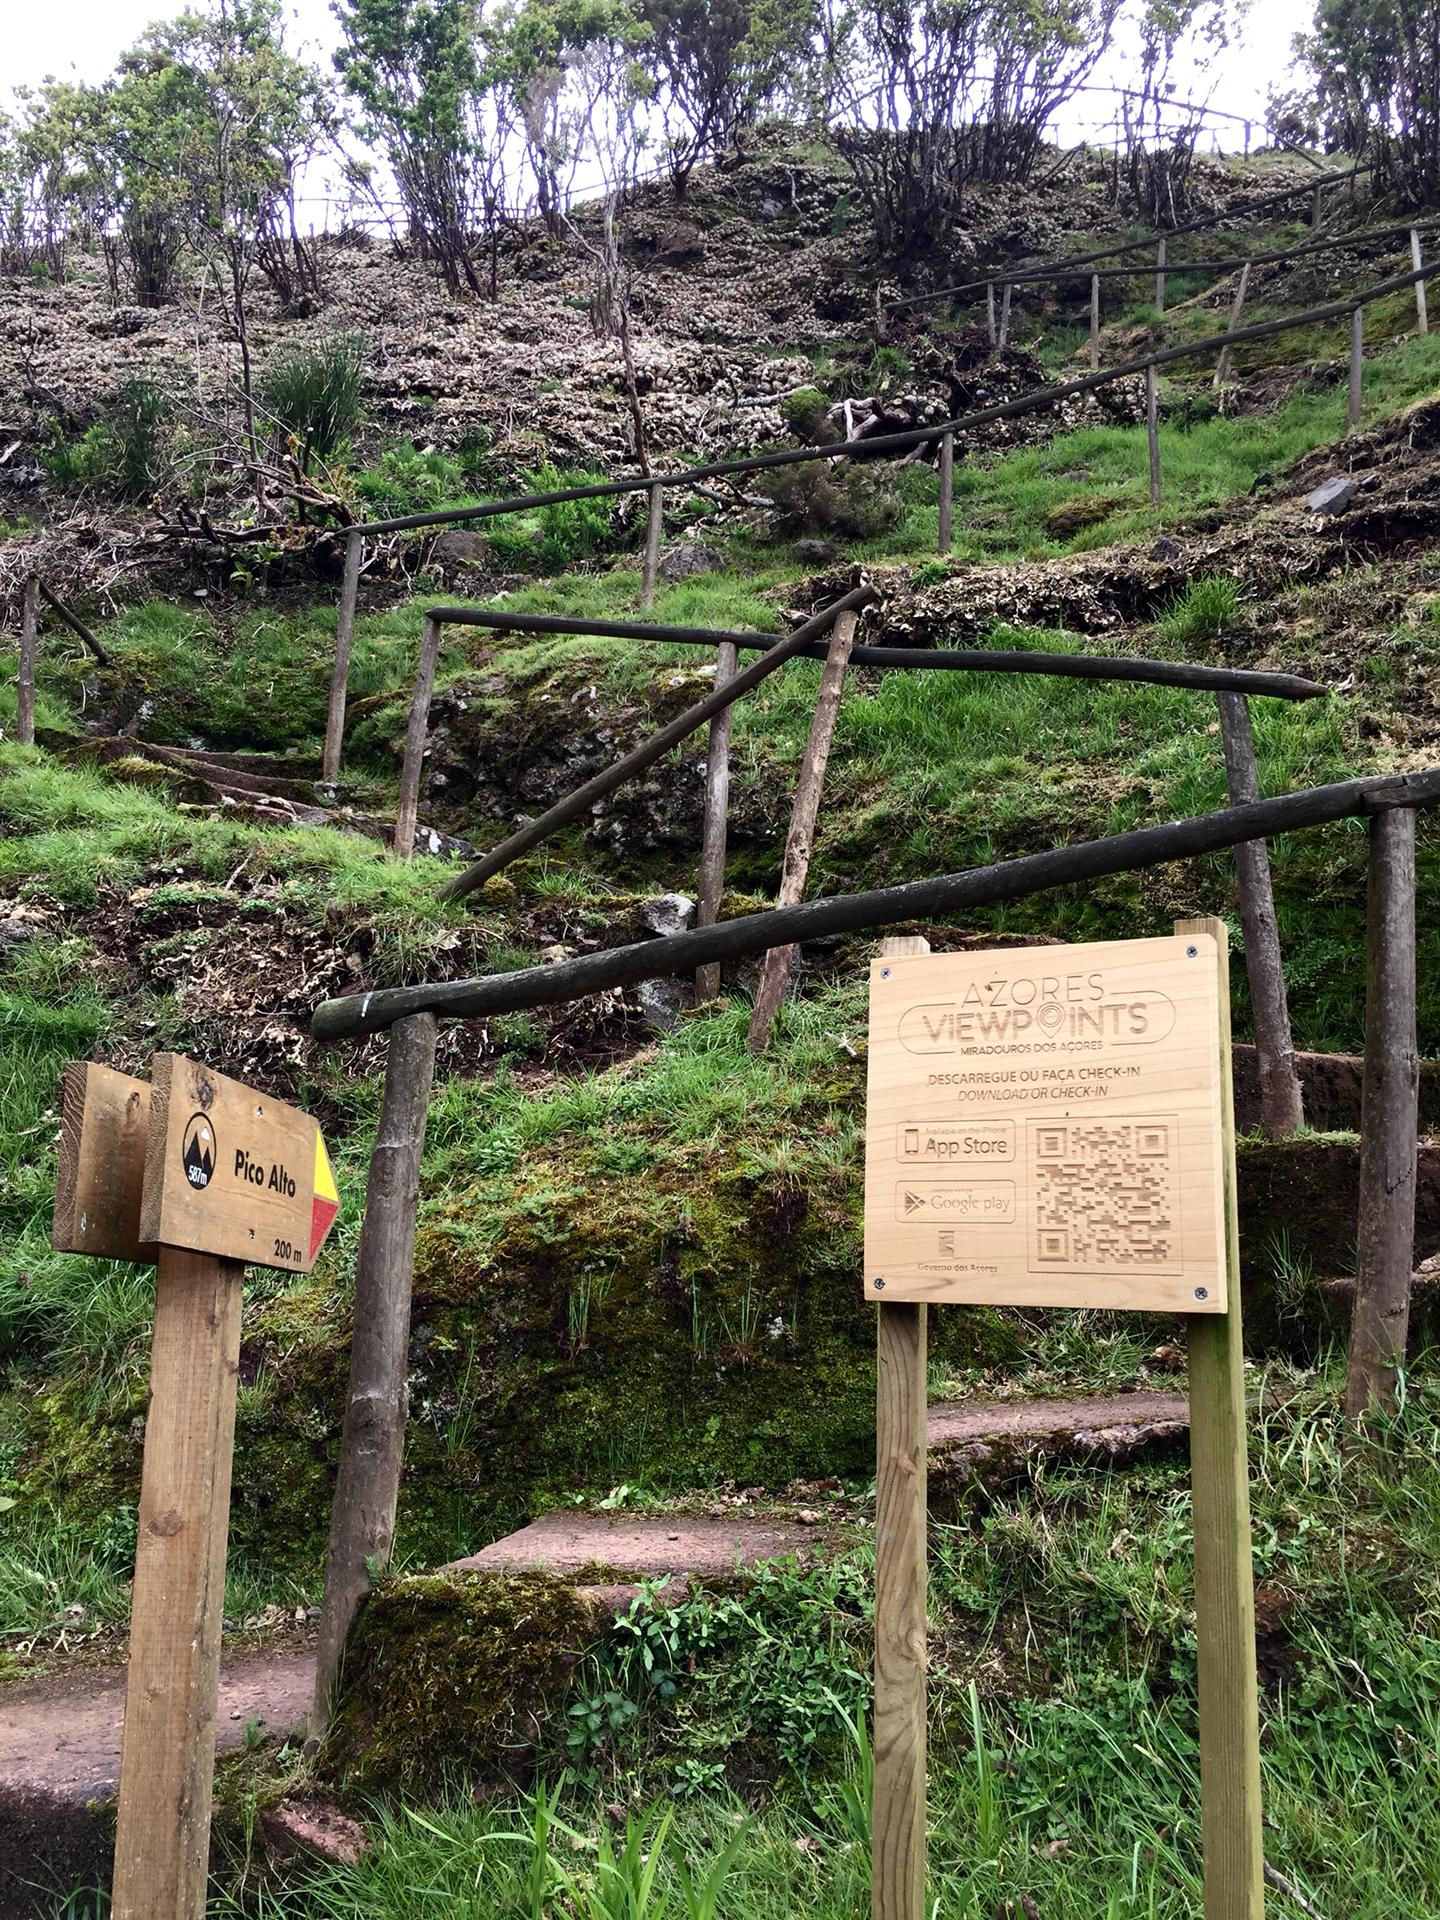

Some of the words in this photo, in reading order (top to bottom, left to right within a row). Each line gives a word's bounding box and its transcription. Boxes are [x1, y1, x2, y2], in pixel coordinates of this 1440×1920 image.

[961, 974, 1104, 1008] AZORES
[961, 1043, 1031, 1056] MIRADOUROS
[1035, 1042, 1056, 1053] DOS
[1061, 1041, 1103, 1054] AÇORES
[928, 1071, 1017, 1085] DESCARREGUE
[1020, 1071, 1039, 1082] OU
[1042, 1069, 1075, 1083] FAÇA
[1079, 1066, 1141, 1080] CHECK-IN
[958, 1088, 1028, 1101] DOWNLOAD
[1031, 1087, 1048, 1099] OR
[1051, 1086, 1109, 1099] CHECK-IN
[925, 1137, 960, 1159] App
[963, 1137, 1007, 1154] Store
[234, 1149, 264, 1186] Pico
[268, 1164, 296, 1198] Alto
[930, 1195, 979, 1214] Google
[983, 1196, 1010, 1213] play
[274, 1238, 292, 1261] 200
[293, 1249, 302, 1263] m
[917, 1263, 952, 1272] Governo
[953, 1264, 968, 1272] dos
[970, 1264, 998, 1273] Açores
